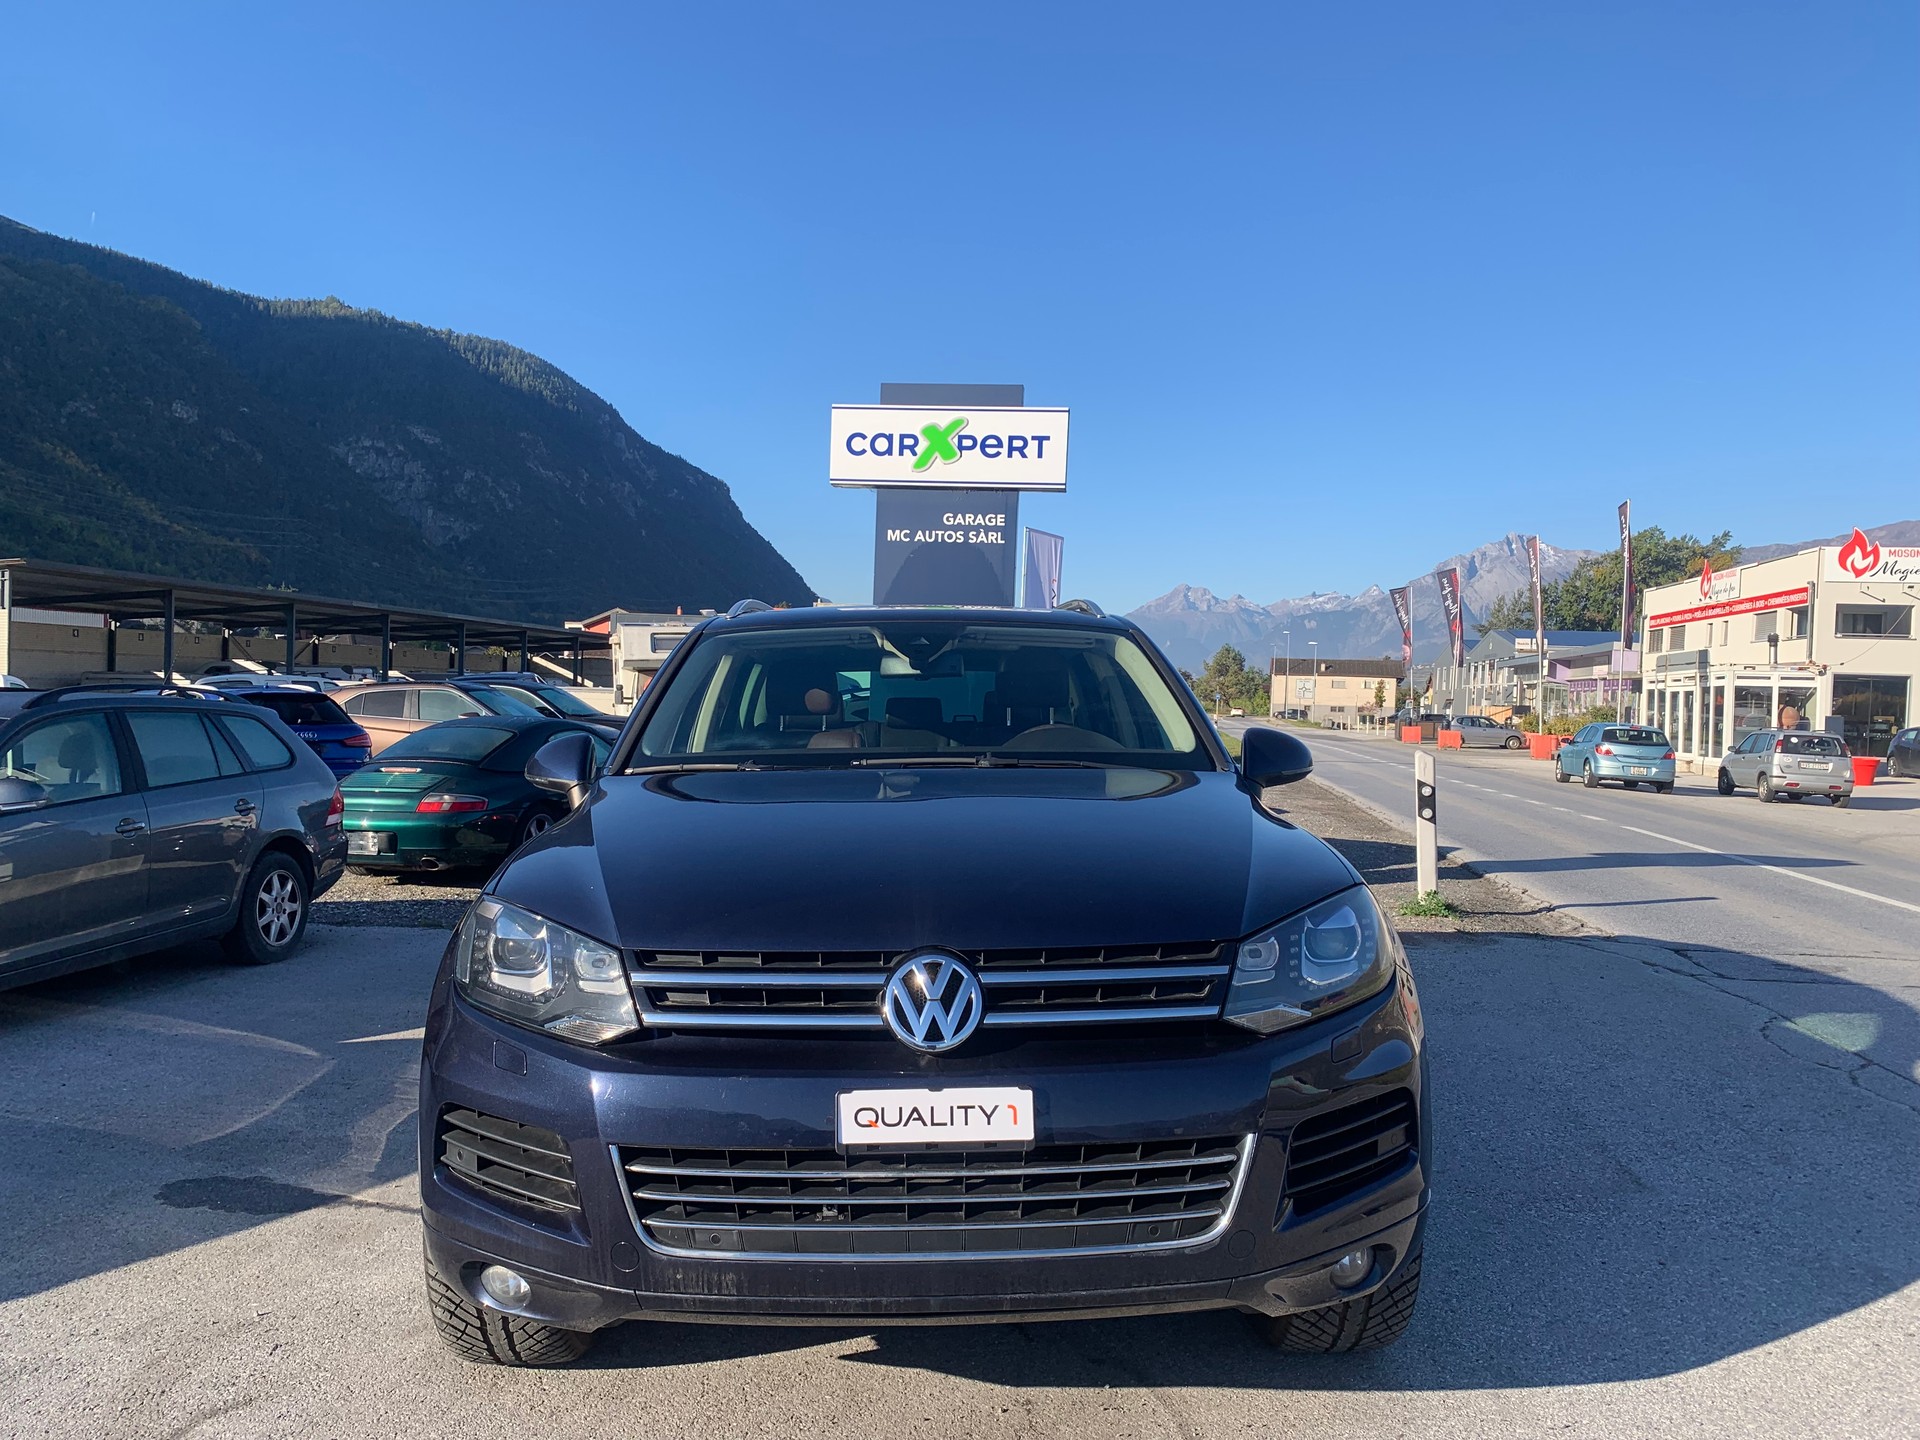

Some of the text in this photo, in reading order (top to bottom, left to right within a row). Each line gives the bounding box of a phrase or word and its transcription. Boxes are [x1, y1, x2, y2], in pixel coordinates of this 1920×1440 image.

[943, 513, 1006, 526] GARAGE
[887, 529, 1006, 544] MC AUTOS SÀRL
[854, 1104, 1018, 1128] QUALITY 1
